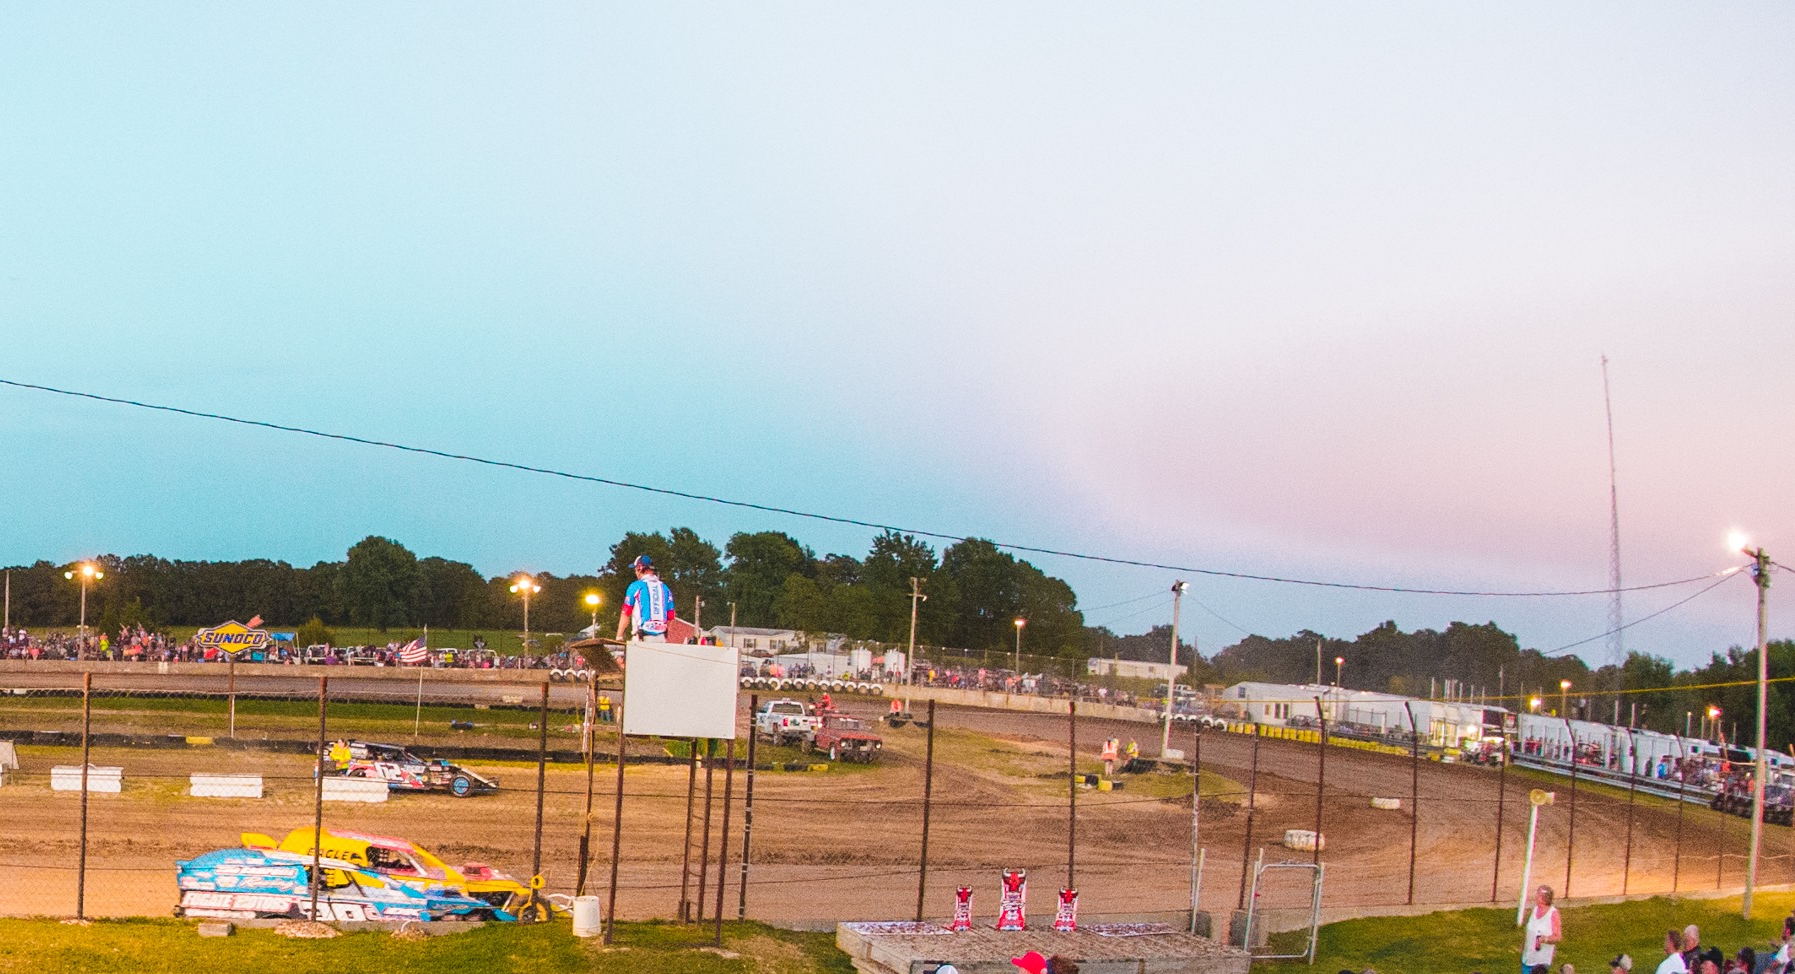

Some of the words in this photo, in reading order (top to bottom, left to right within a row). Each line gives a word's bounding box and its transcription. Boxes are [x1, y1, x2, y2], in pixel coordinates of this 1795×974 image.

[652, 585, 660, 615] OFFICIAL
[203, 632, 264, 644] SUNOCO
[307, 848, 348, 860] EAGLE
